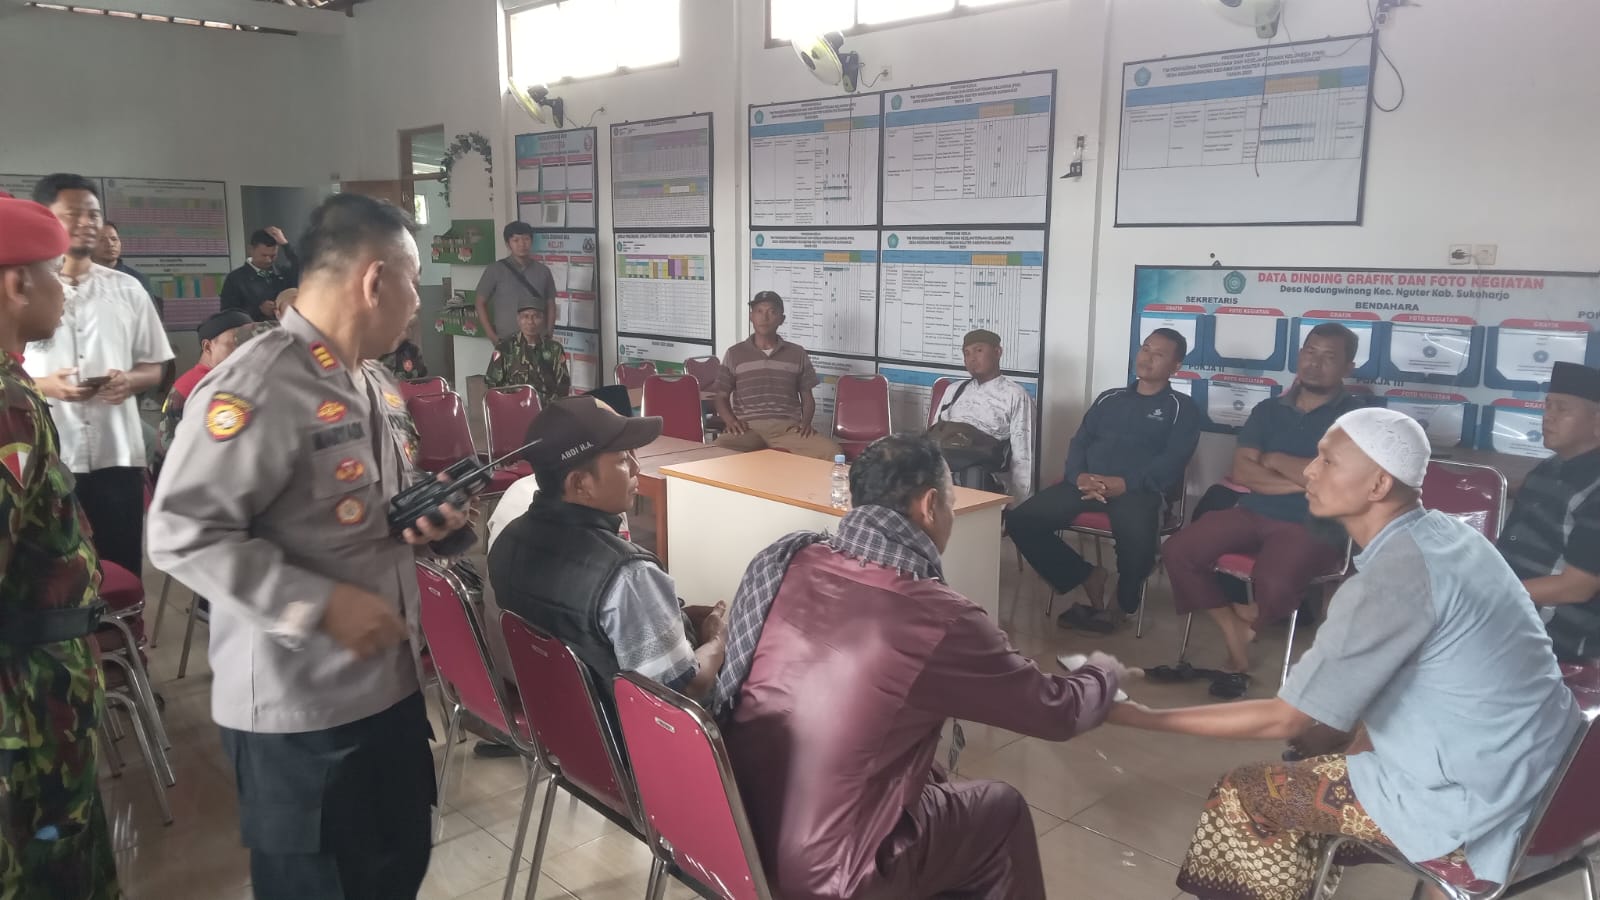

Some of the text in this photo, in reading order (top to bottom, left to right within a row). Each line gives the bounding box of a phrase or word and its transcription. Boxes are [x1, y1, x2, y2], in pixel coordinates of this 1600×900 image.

[1258, 272, 1545, 289] DATA DINDING GRAFIK DAN FOTO KEGIATAN
[1280, 285, 1510, 301] Desa Kedungwinong Kec. Nguter Kab. Sukoharjo
[1185, 296, 1238, 305] SEKRETARIS
[1355, 301, 1420, 311] BENDAHARA
[561, 447, 579, 460] ABDI
